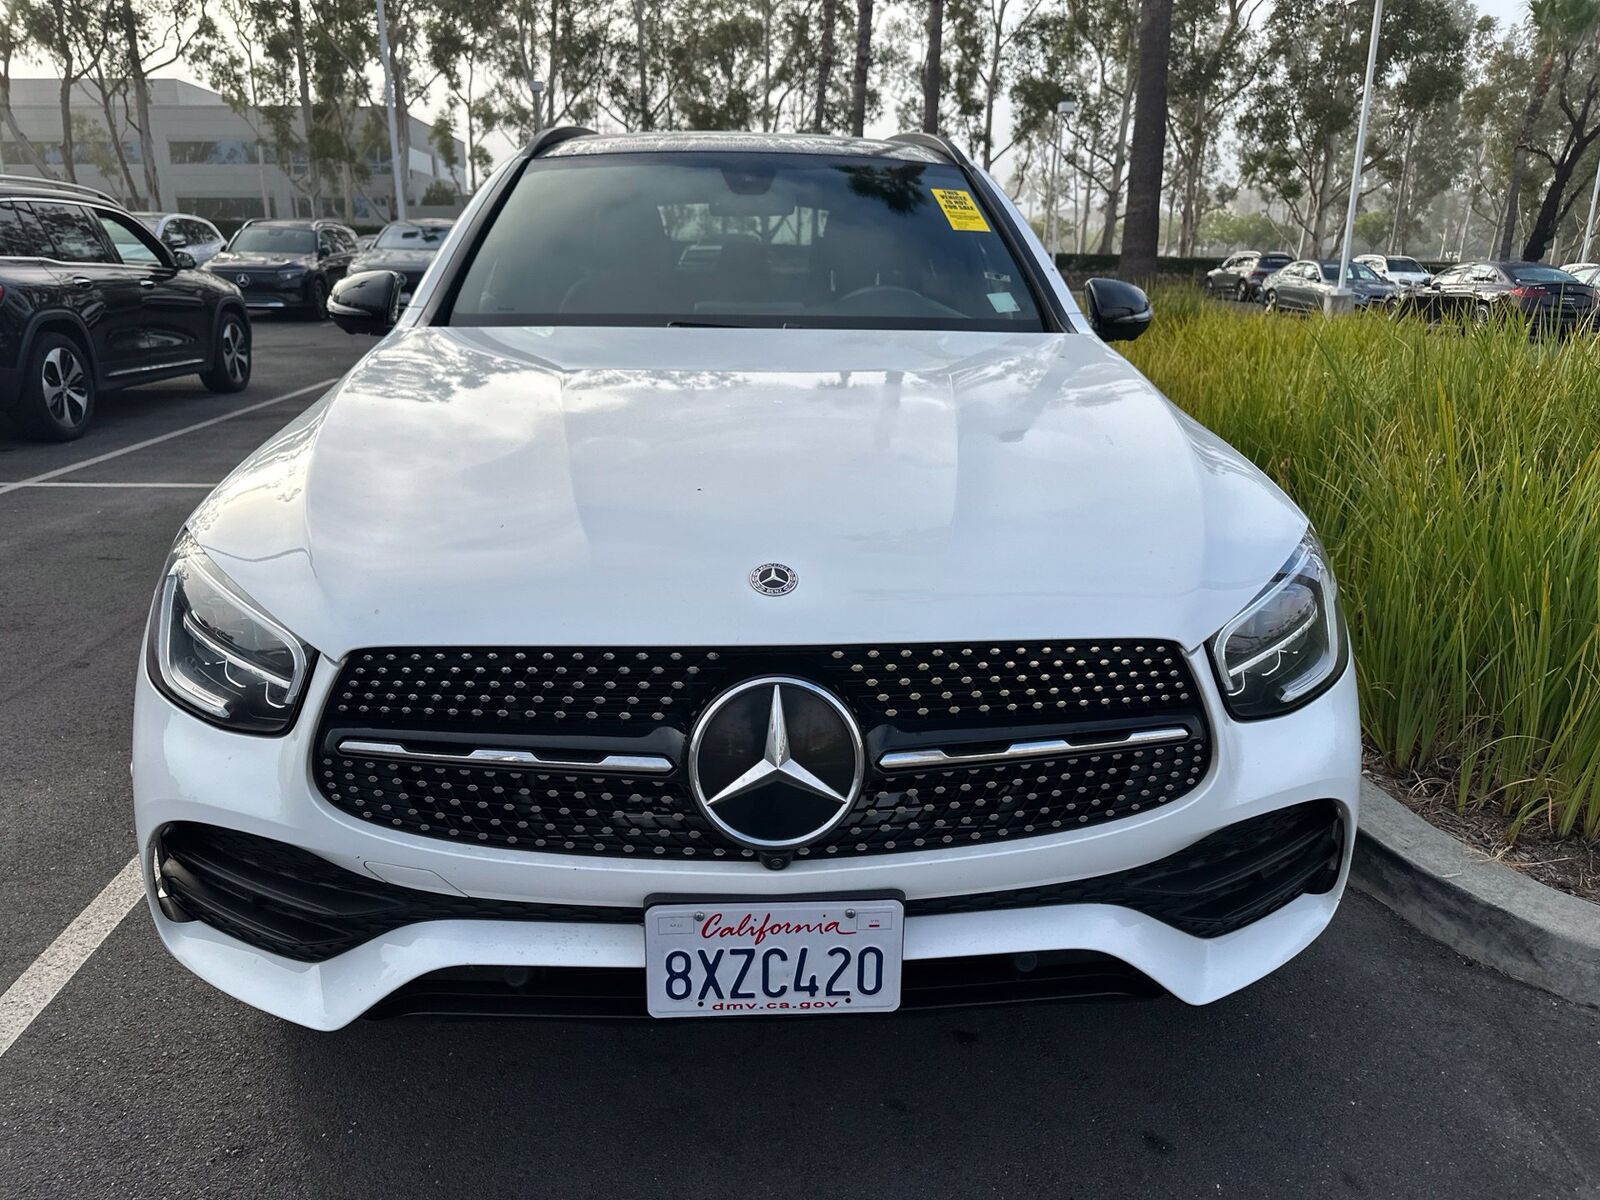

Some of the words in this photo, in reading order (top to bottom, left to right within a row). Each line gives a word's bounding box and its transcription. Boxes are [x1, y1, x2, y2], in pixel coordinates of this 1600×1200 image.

[701, 913, 856, 945] California
[665, 946, 884, 1001] 8XZC420
[712, 1001, 838, 1011] dmv.ca.gov
